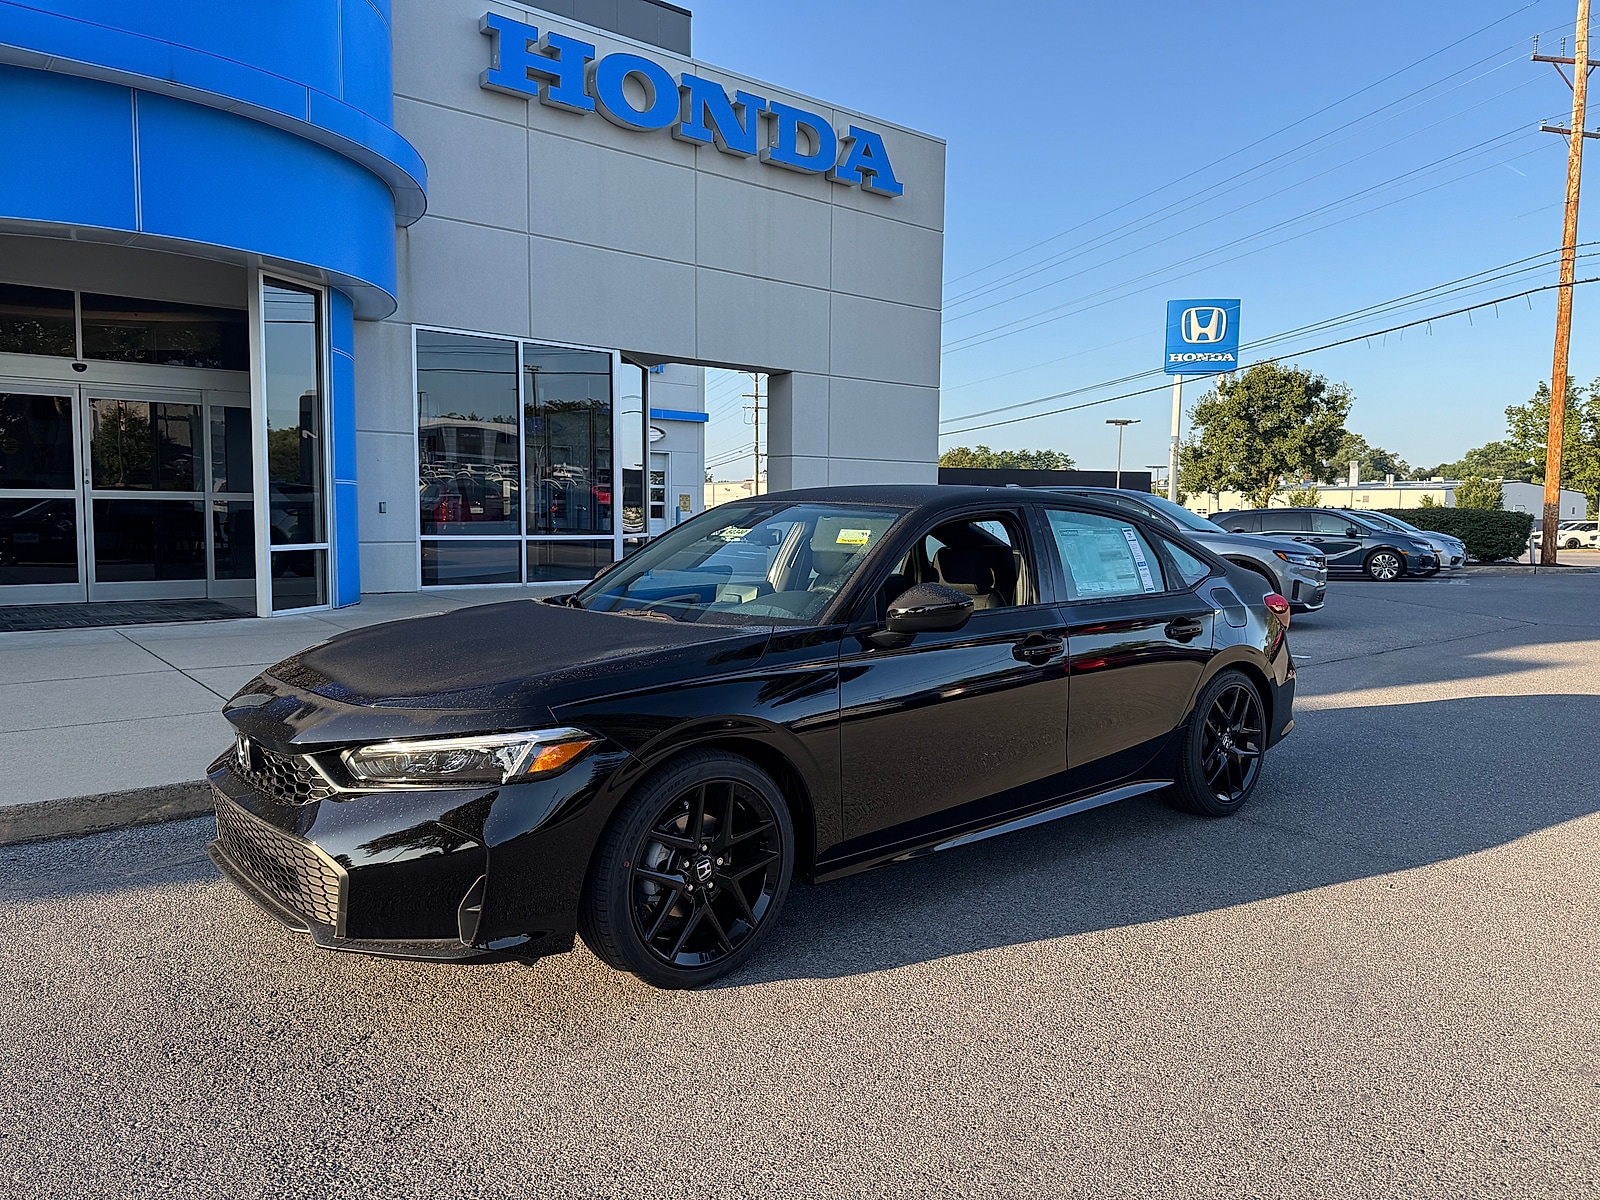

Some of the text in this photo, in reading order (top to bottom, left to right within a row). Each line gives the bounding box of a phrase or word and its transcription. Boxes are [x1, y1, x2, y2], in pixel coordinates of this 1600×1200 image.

[480, 12, 904, 197] HONDA
[1169, 353, 1235, 362] HONDA
[655, 776, 688, 804] SPORT
